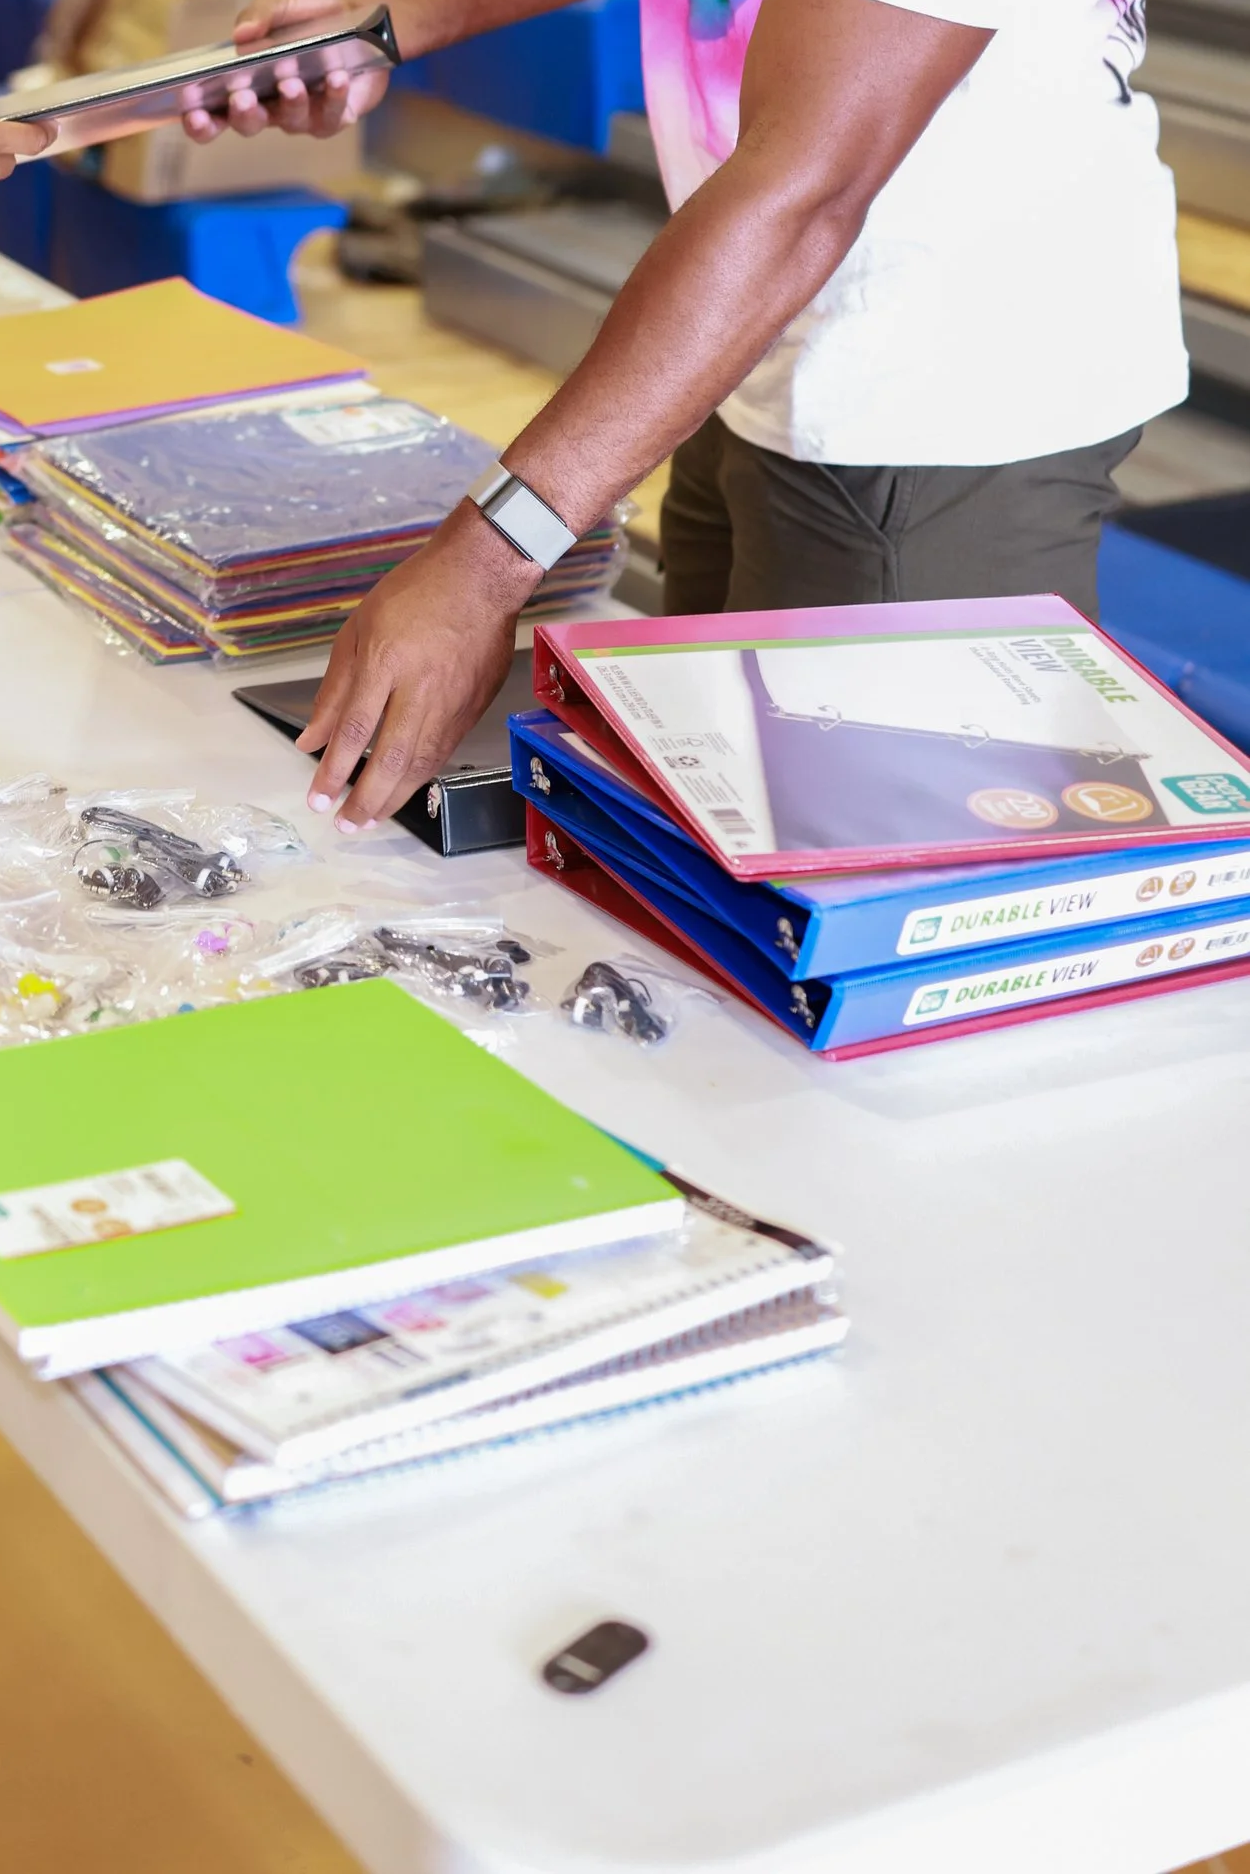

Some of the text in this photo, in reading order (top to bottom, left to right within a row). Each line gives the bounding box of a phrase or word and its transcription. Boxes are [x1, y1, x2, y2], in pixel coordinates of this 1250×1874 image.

[1009, 638, 1068, 673] VIEW
[1043, 636, 1139, 703] DURABLE
[1005, 795, 1049, 819] 220
[950, 900, 1045, 933] DURABLE
[1049, 891, 1098, 916] VIEW
[954, 970, 1047, 1004] DURABLE
[1051, 959, 1100, 984] VIEW
